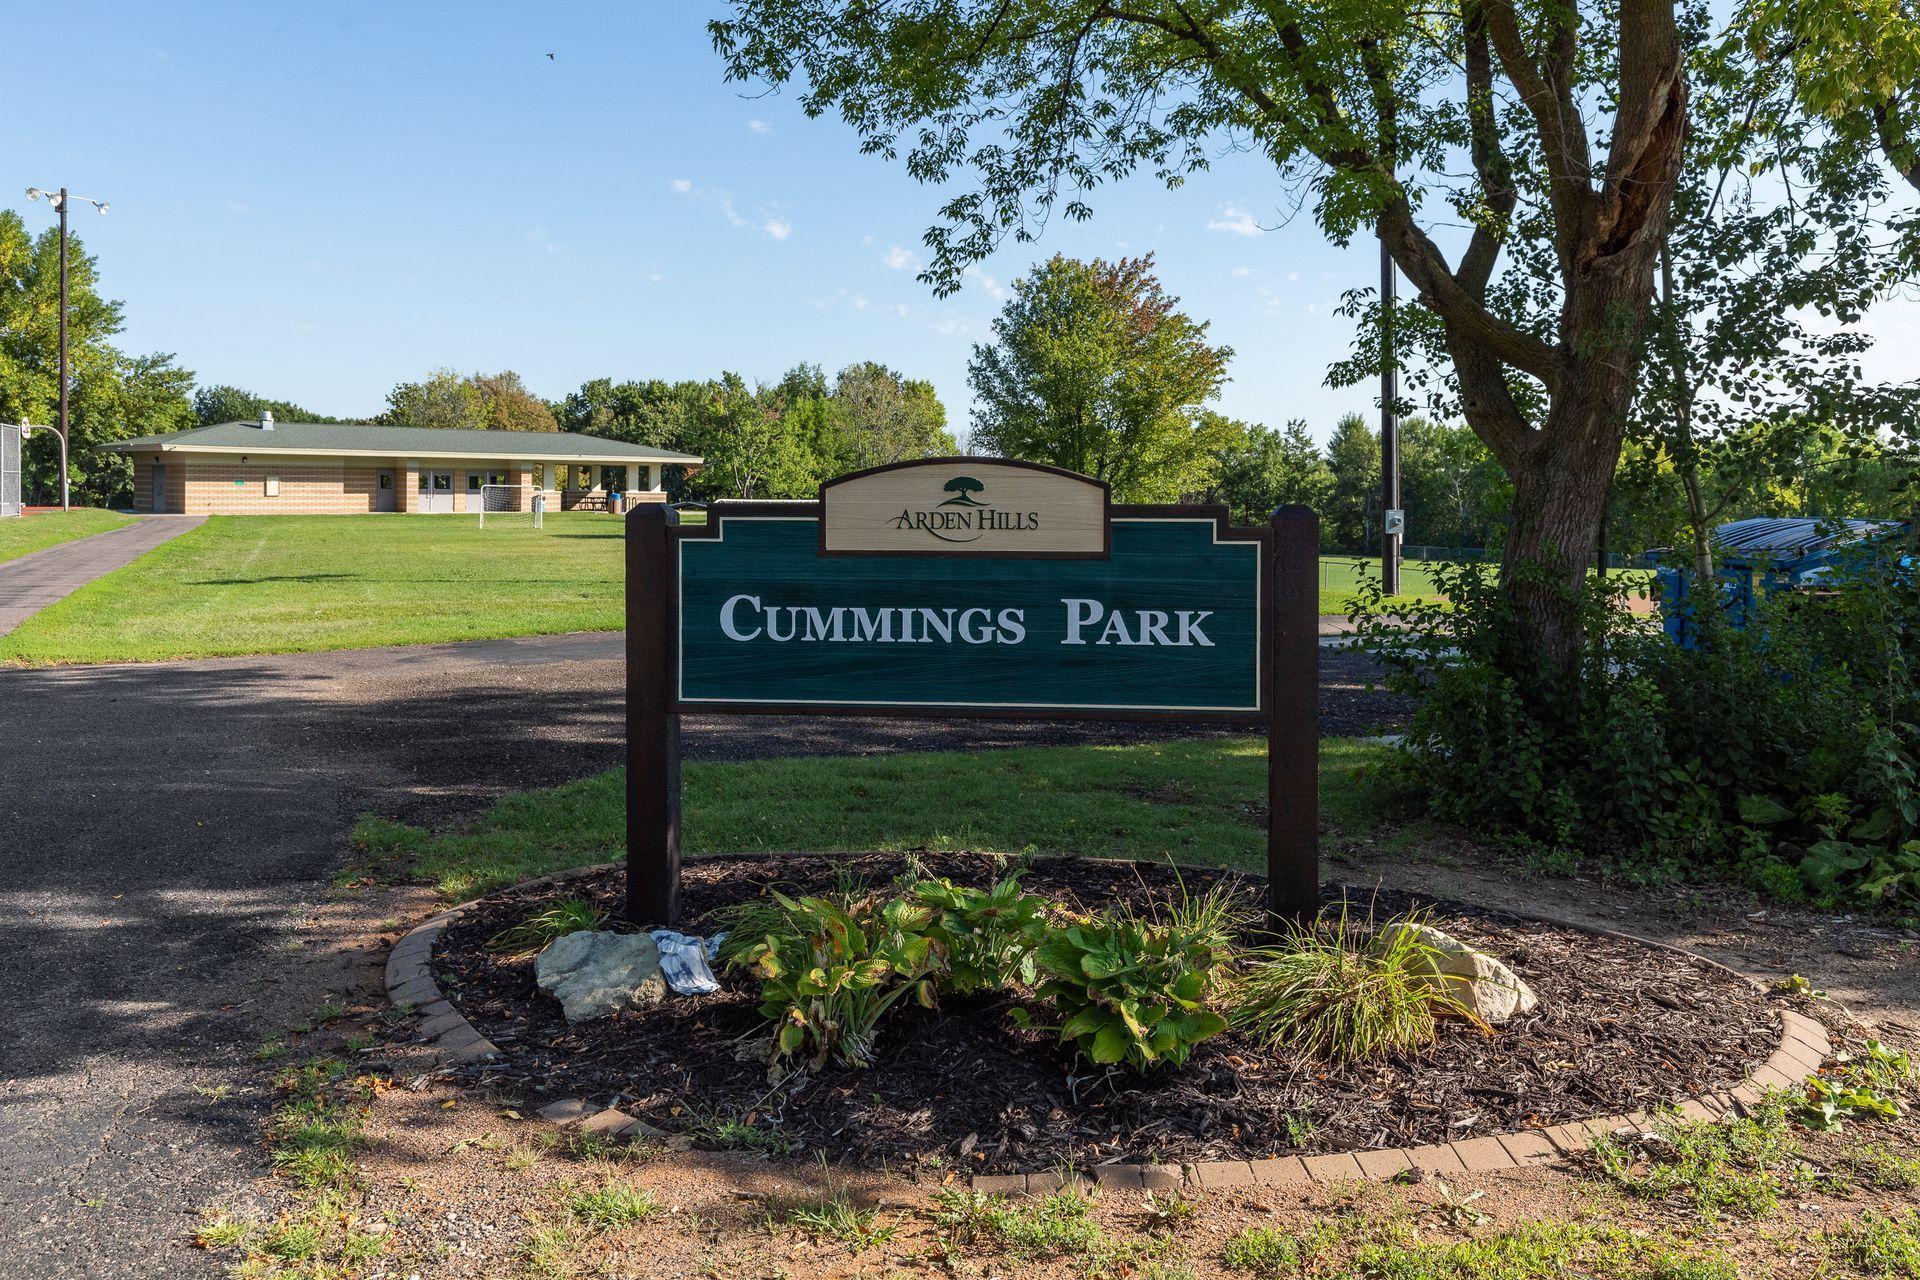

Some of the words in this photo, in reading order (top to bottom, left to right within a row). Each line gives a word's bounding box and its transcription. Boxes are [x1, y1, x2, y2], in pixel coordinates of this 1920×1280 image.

[895, 508, 973, 531] ARDEN
[976, 509, 1039, 531] HILLS
[719, 594, 1026, 645] CUMMINGS
[1060, 598, 1216, 647] PARK
